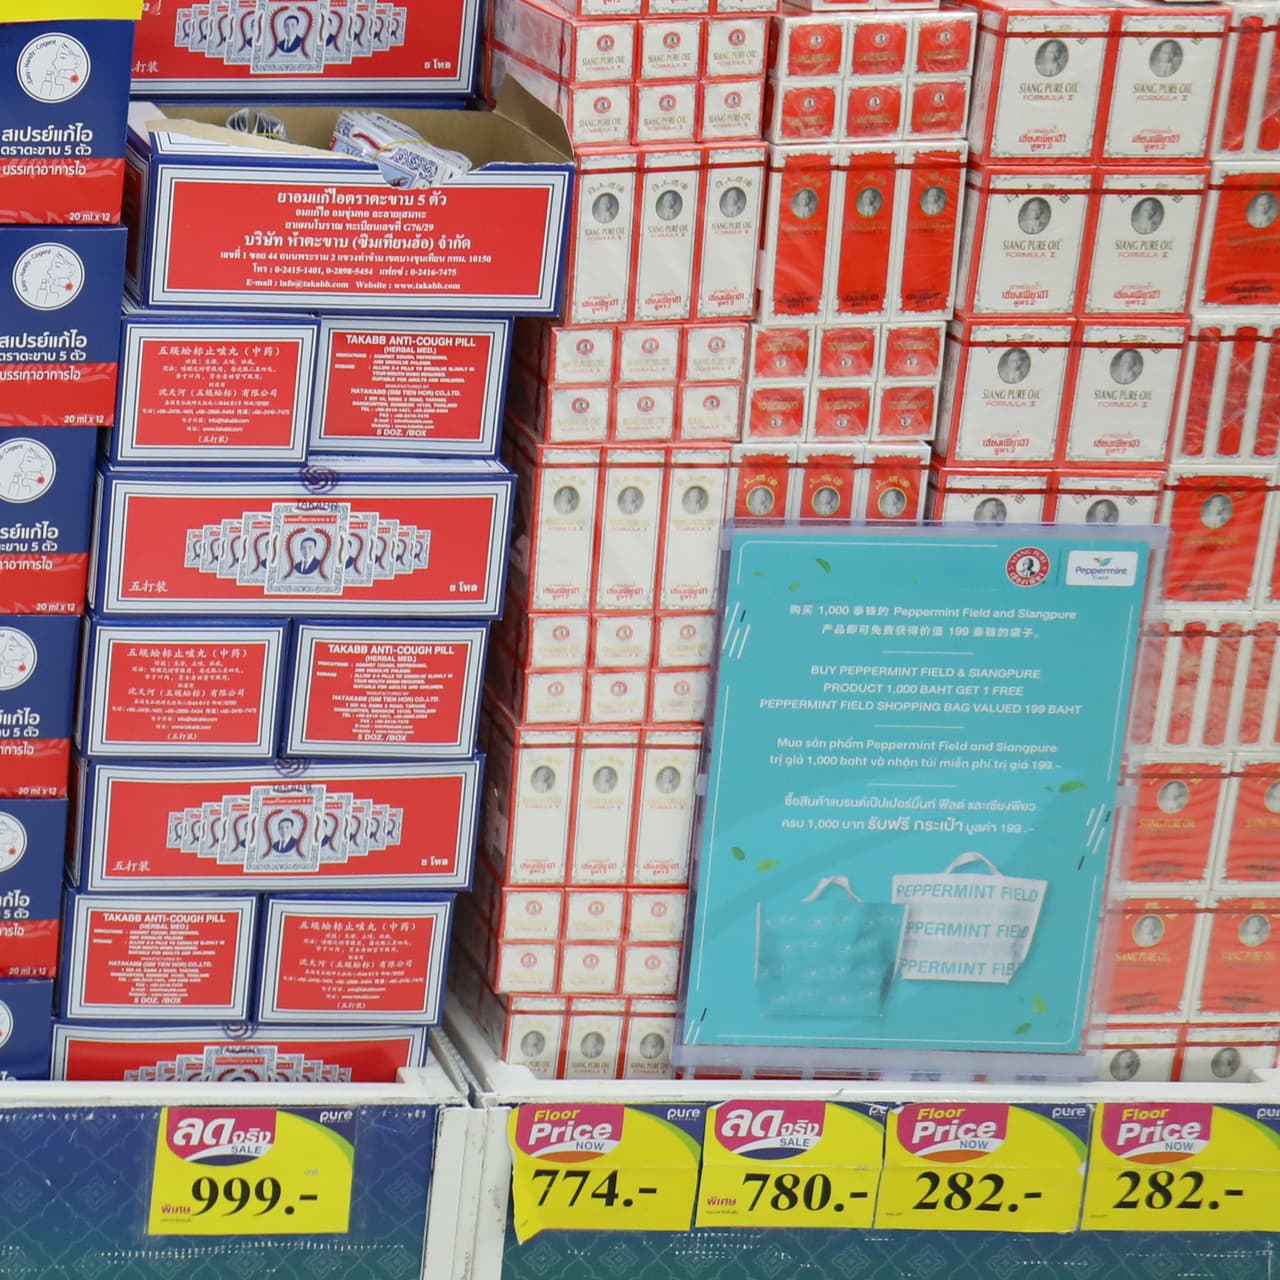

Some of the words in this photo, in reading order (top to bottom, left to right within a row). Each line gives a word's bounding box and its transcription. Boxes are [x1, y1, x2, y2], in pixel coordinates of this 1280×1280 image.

[1019, 82, 1043, 93] SIANG
[1044, 82, 1065, 94] PURE
[1067, 82, 1079, 94] OIL
[1, 122, 93, 142] สเปรย์แก้ไอ
[0, 145, 60, 155] ตราตะขาบ
[64, 145, 72, 155] 5
[75, 144, 92, 155] ตัว
[3, 160, 86, 176] บรรเทาอาการไอ
[277, 188, 415, 207] ยาอมแก้ไอตราตะขาบ
[417, 192, 425, 206] 5
[429, 192, 447, 206] ตัว
[69, 212, 81, 220] 20
[82, 213, 93, 221] ml
[101, 213, 110, 221] 12
[245, 231, 283, 247] บริษัท
[288, 232, 349, 248] ห้าตะขาบ
[438, 234, 471, 250] จำกัด
[246, 279, 273, 287] E-mail
[356, 280, 387, 288] Website
[346, 335, 386, 345] TAKABB
[389, 336, 453, 347] ANTI-COUGH
[455, 338, 476, 347] PILL
[1075, 566, 1128, 578] Peppermint
[811, 665, 837, 676] BUY
[840, 666, 918, 677] PEPPERMINT
[921, 667, 954, 678] FIELD
[957, 668, 965, 678] &
[968, 668, 1040, 679] SIANGPURE
[824, 683, 883, 694] PRODUCT
[886, 684, 917, 695] 1,000
[920, 684, 954, 695] BAHT
[956, 685, 980, 696] GET
[993, 686, 1024, 696] FREE
[760, 699, 838, 710] PEPPERMINT
[840, 700, 874, 711] FIELD
[877, 701, 941, 712] SHOPPING
[944, 702, 970, 713] BAG
[973, 703, 1021, 714] VALUED
[1025, 704, 1045, 714] 199
[1048, 705, 1082, 715] BAHT
[896, 882, 996, 900] PEPPERMINT
[1001, 886, 1039, 903] FIELD
[534, 1108, 581, 1122] Floor
[720, 1109, 820, 1139] ลดจริง
[528, 1119, 612, 1145] Price
[912, 1117, 995, 1145] Price
[191, 1175, 318, 1217] 999.-
[531, 1168, 657, 1208] 774.-
[743, 1171, 869, 1212] 780.-
[913, 1171, 1043, 1213] 282.-
[1112, 1171, 1244, 1212] 282.-
